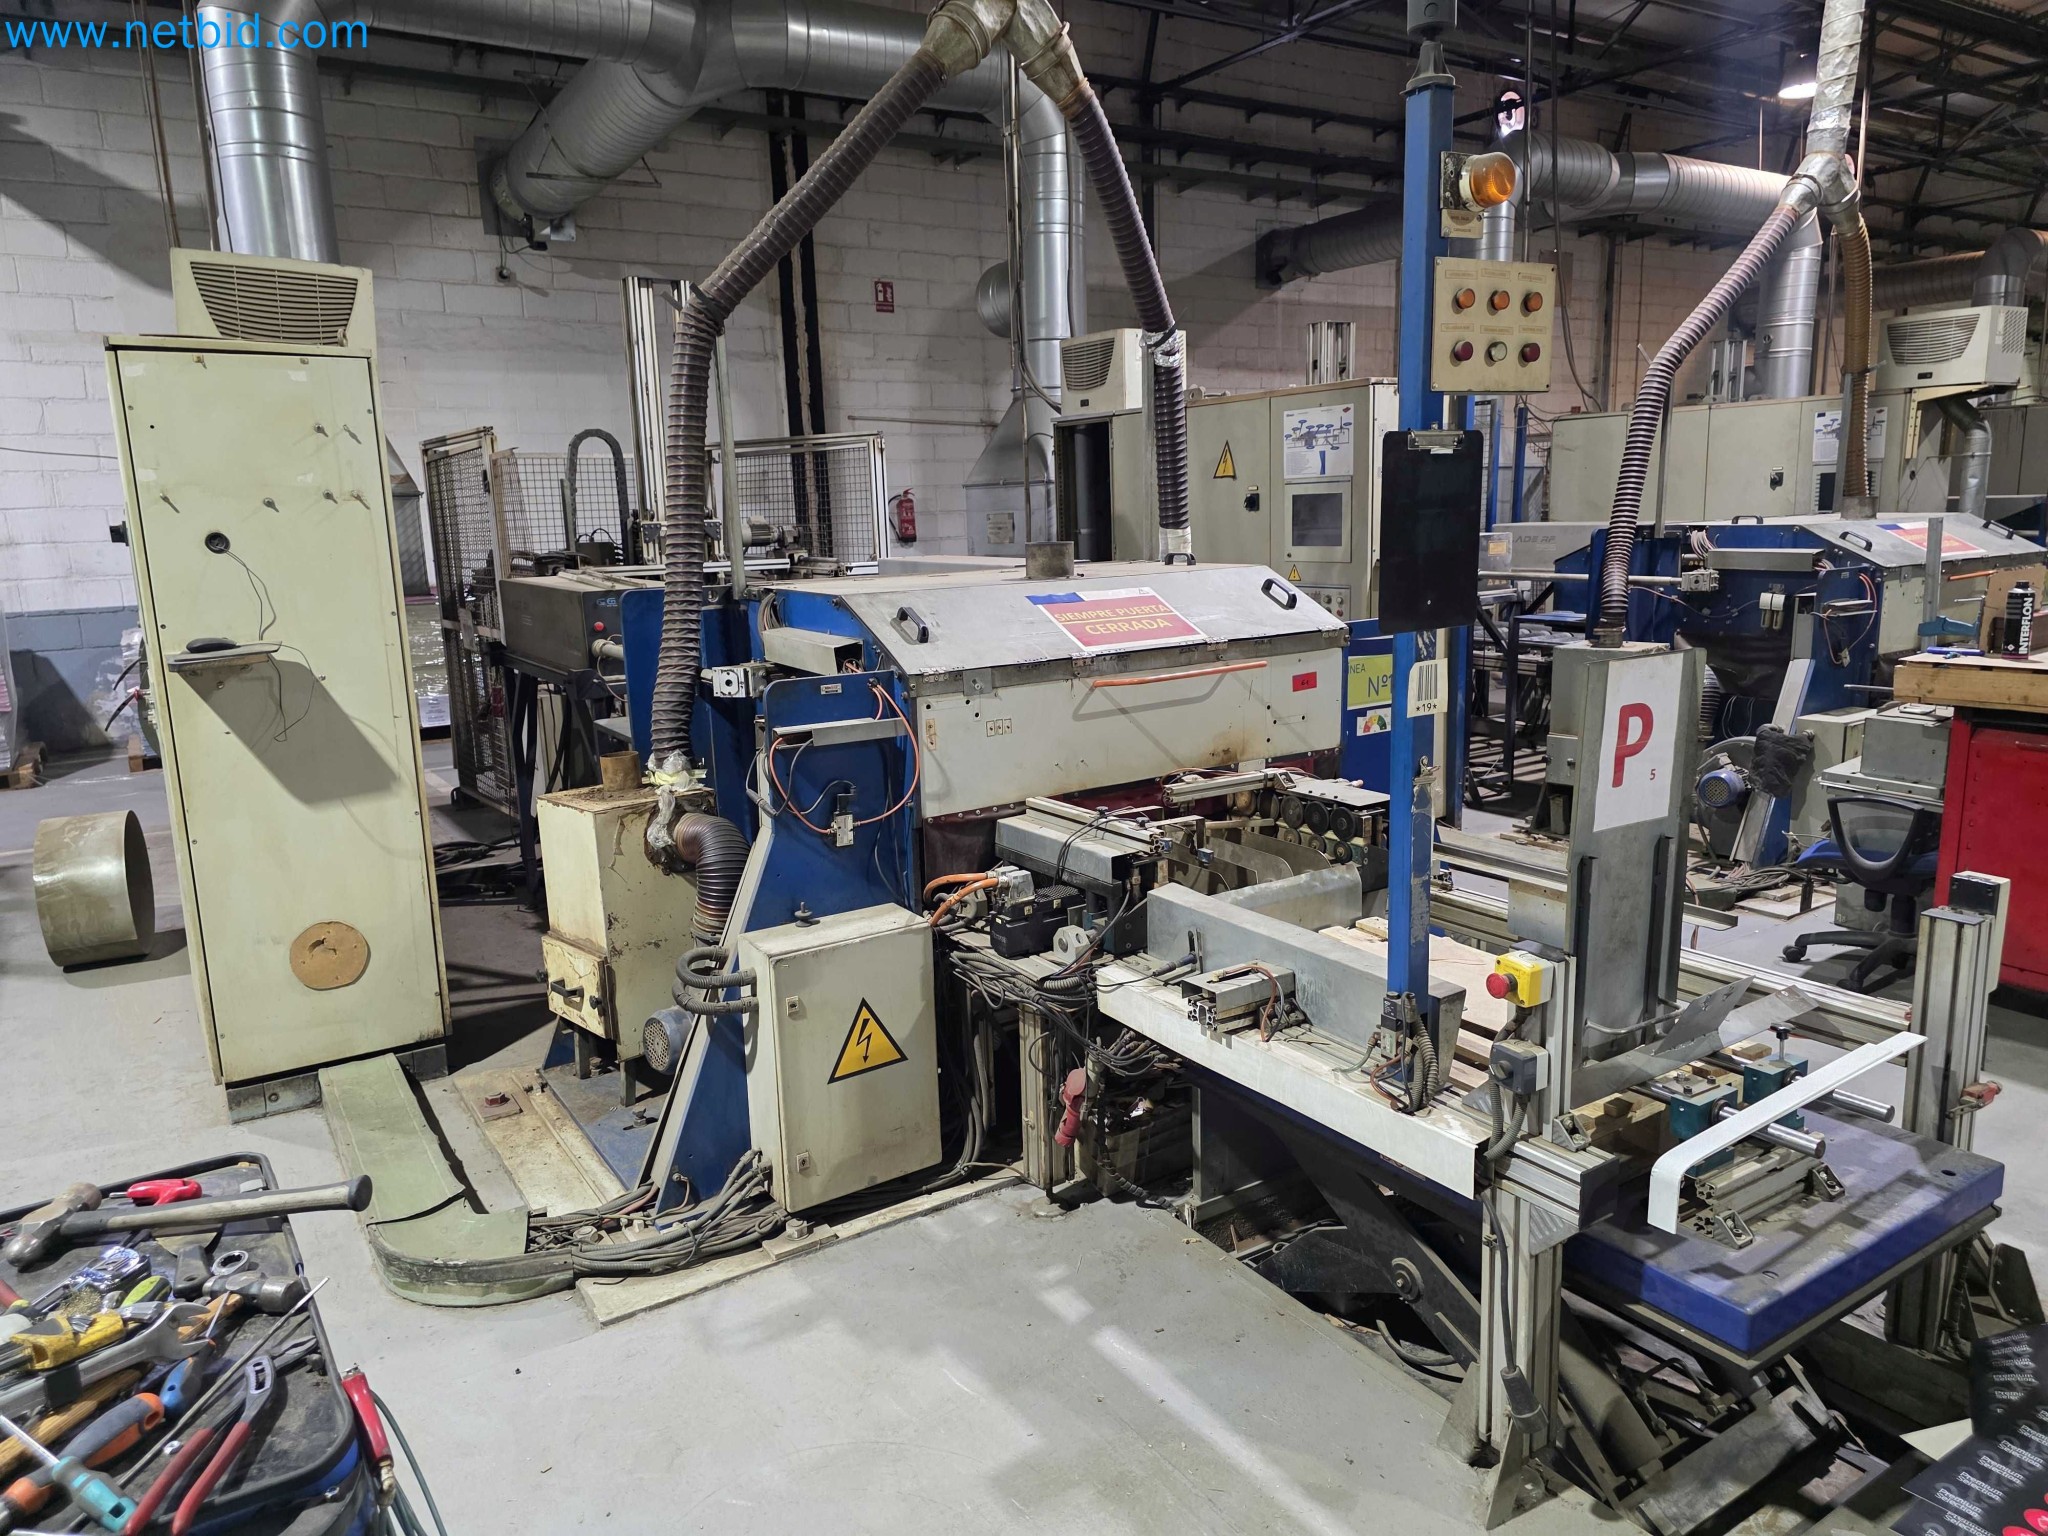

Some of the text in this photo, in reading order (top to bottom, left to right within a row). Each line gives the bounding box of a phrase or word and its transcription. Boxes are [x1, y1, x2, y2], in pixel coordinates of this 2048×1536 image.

[1055, 604, 1169, 622] SIEMPRE PUERTA
[1086, 618, 1172, 635] CERRADA
[2018, 597, 2034, 655] INTERFLON
[1611, 702, 1654, 788] P
[1649, 768, 1656, 781] 5
[1997, 1443, 2041, 1468] Selection
[2001, 1440, 2044, 1463] Premium
[1976, 1459, 2021, 1485] Selection
[1980, 1455, 2025, 1480] Premium
[1956, 1475, 2000, 1501] Selection
[1959, 1471, 2003, 1496] Premium
[1934, 1492, 1979, 1518] Selection
[1938, 1488, 1982, 1514] Premium
